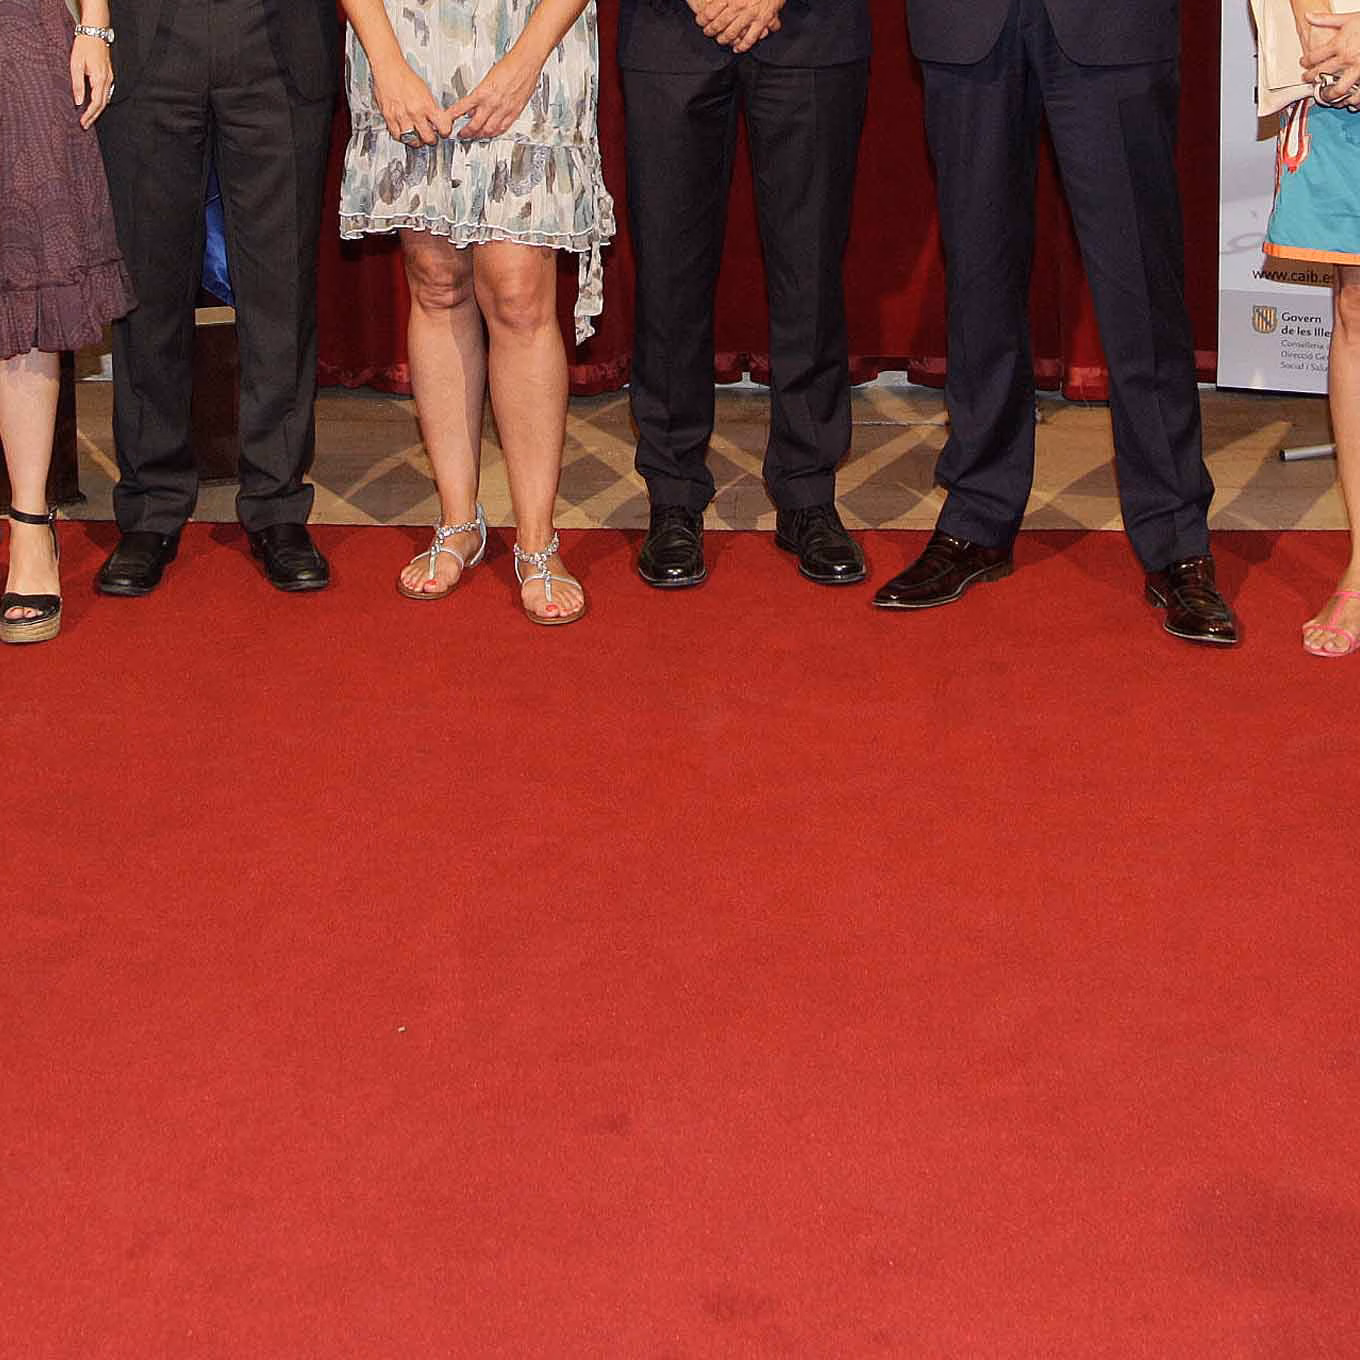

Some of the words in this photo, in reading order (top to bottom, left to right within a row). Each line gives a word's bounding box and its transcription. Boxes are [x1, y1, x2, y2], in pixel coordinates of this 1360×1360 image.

[1281, 311, 1322, 323] Govern
[1281, 325, 1294, 335] de
[1297, 326, 1311, 336] les
[1314, 327, 1332, 338] Ille
